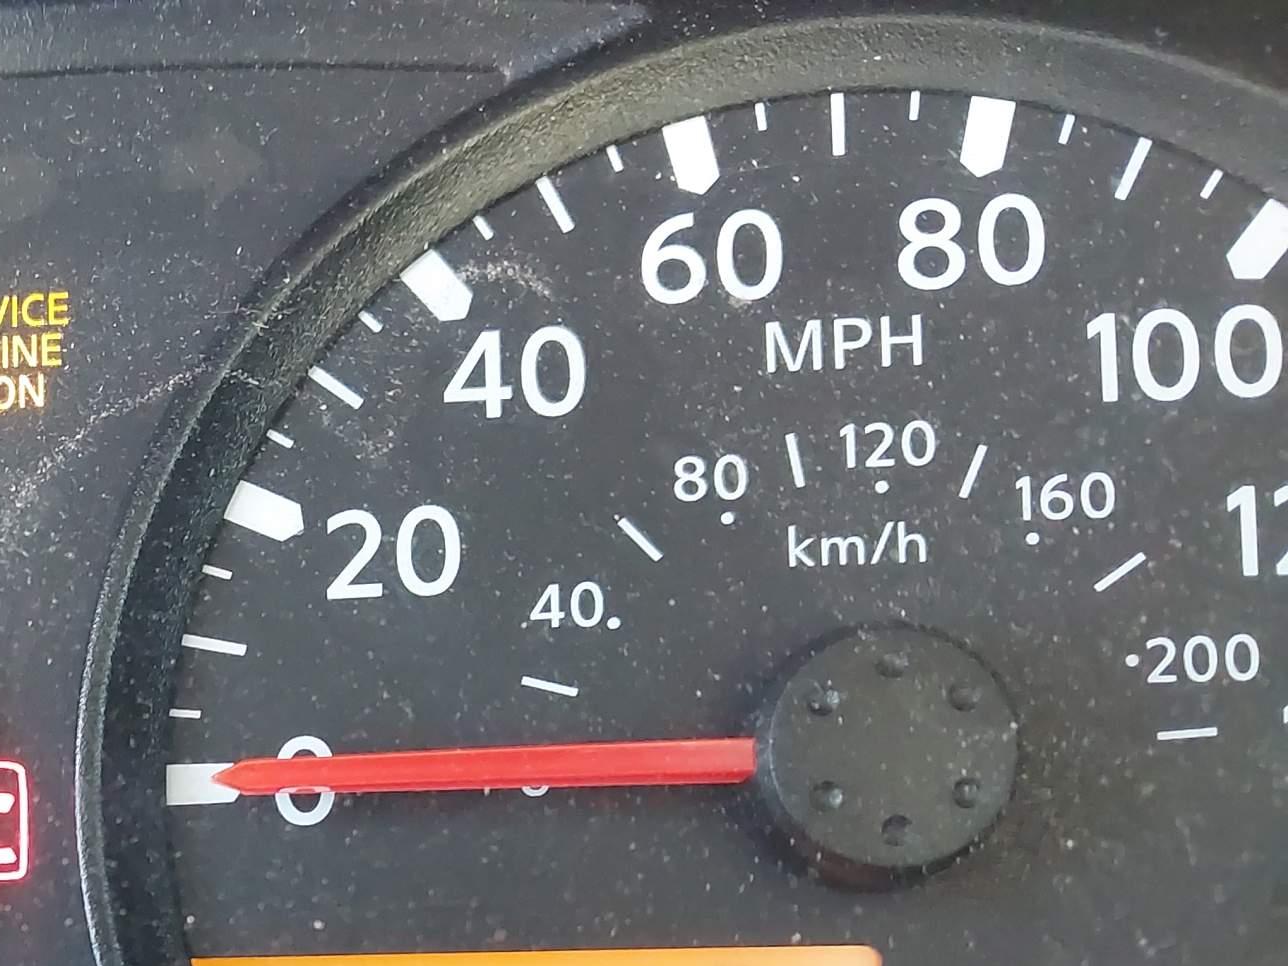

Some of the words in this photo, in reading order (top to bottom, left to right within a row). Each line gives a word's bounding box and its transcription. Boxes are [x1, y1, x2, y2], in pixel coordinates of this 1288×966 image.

[640, 209, 783, 305] 60
[896, 193, 1047, 291] 80
[443, 325, 586, 419] 40
[765, 314, 924, 375] MPH
[1086, 304, 1283, 403] 100
[838, 419, 936, 469] 120
[673, 454, 748, 502] 80
[1014, 471, 1115, 521] 160
[325, 504, 461, 600] 20
[786, 521, 929, 568] km/h
[528, 581, 604, 628] 40
[1145, 633, 1260, 684] 200
